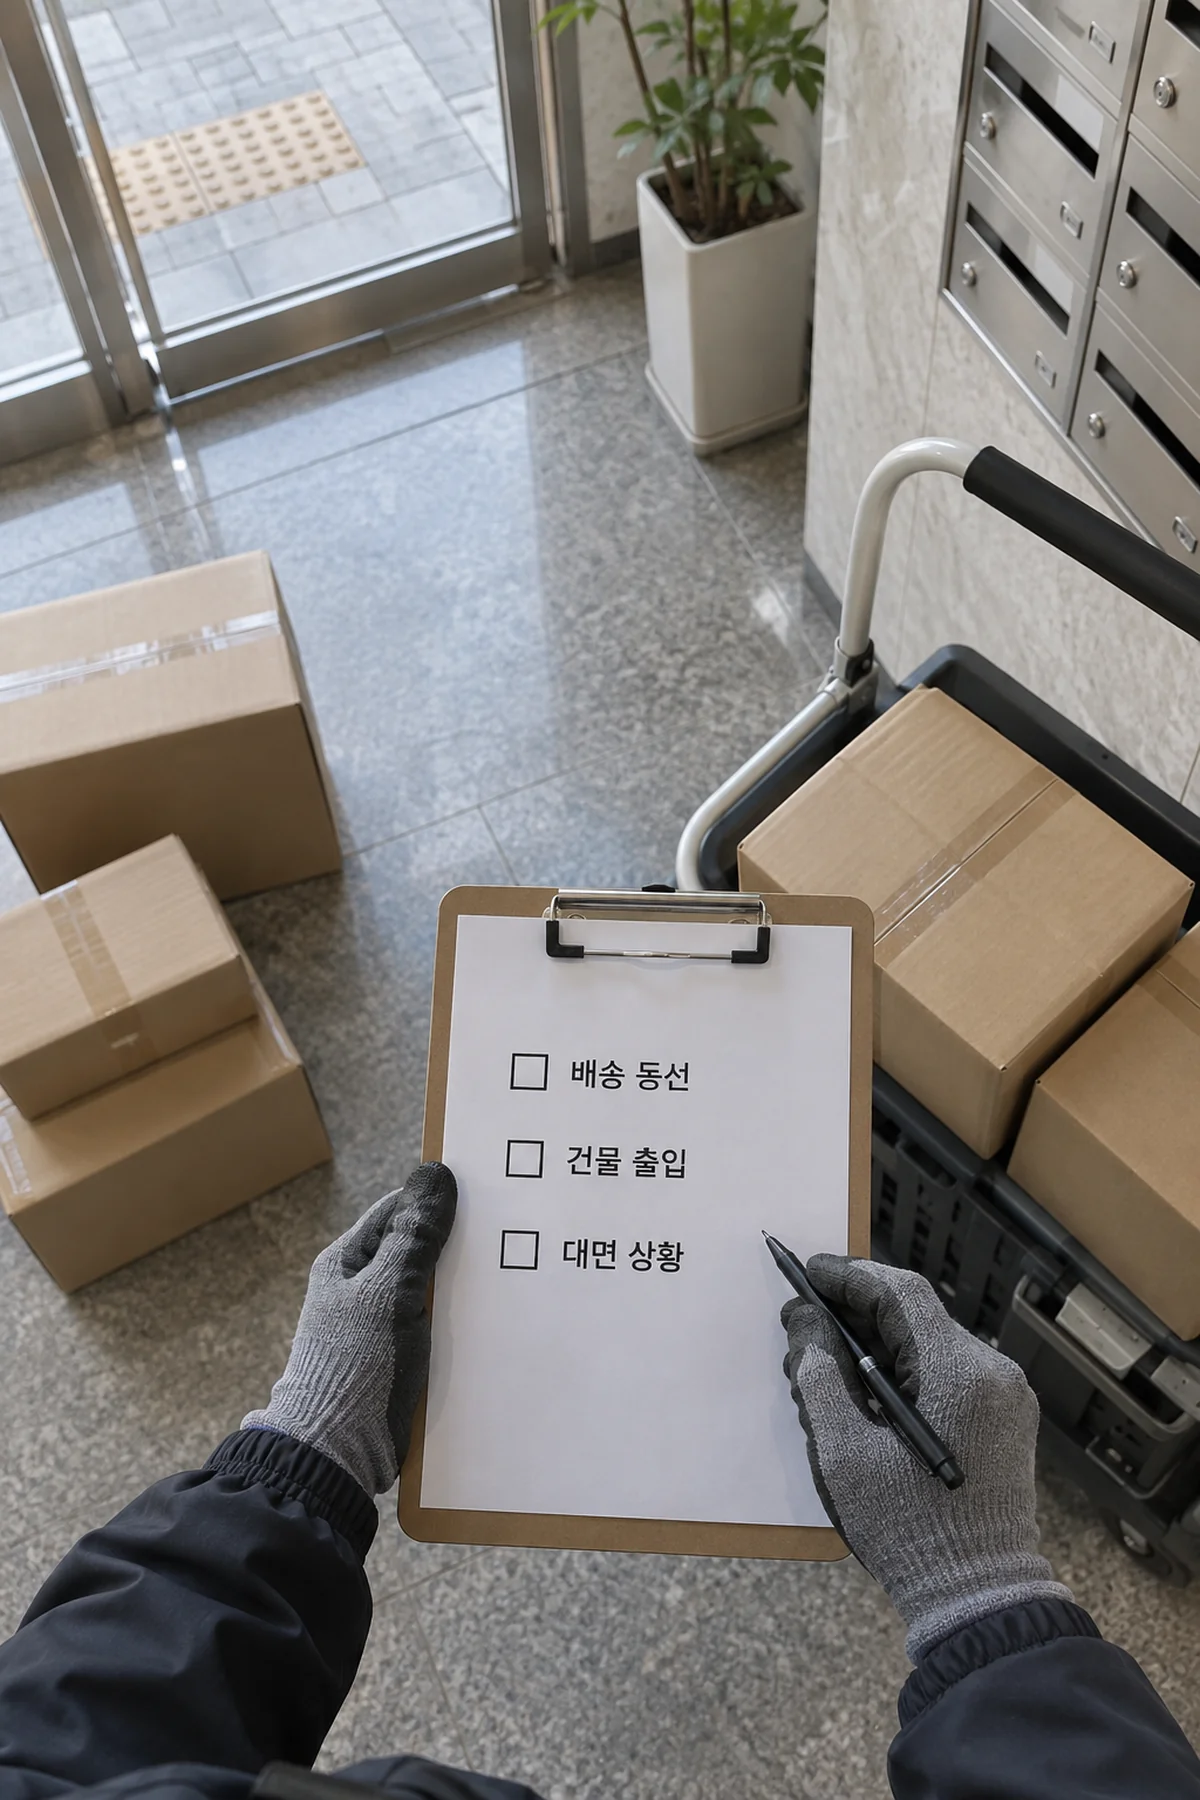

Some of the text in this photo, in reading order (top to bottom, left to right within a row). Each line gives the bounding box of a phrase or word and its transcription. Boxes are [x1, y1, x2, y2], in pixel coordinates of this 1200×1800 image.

[571, 1058, 689, 1092] 배송 동선
[566, 1145, 686, 1179] 건물 출입
[562, 1238, 685, 1273] 대면 상황
